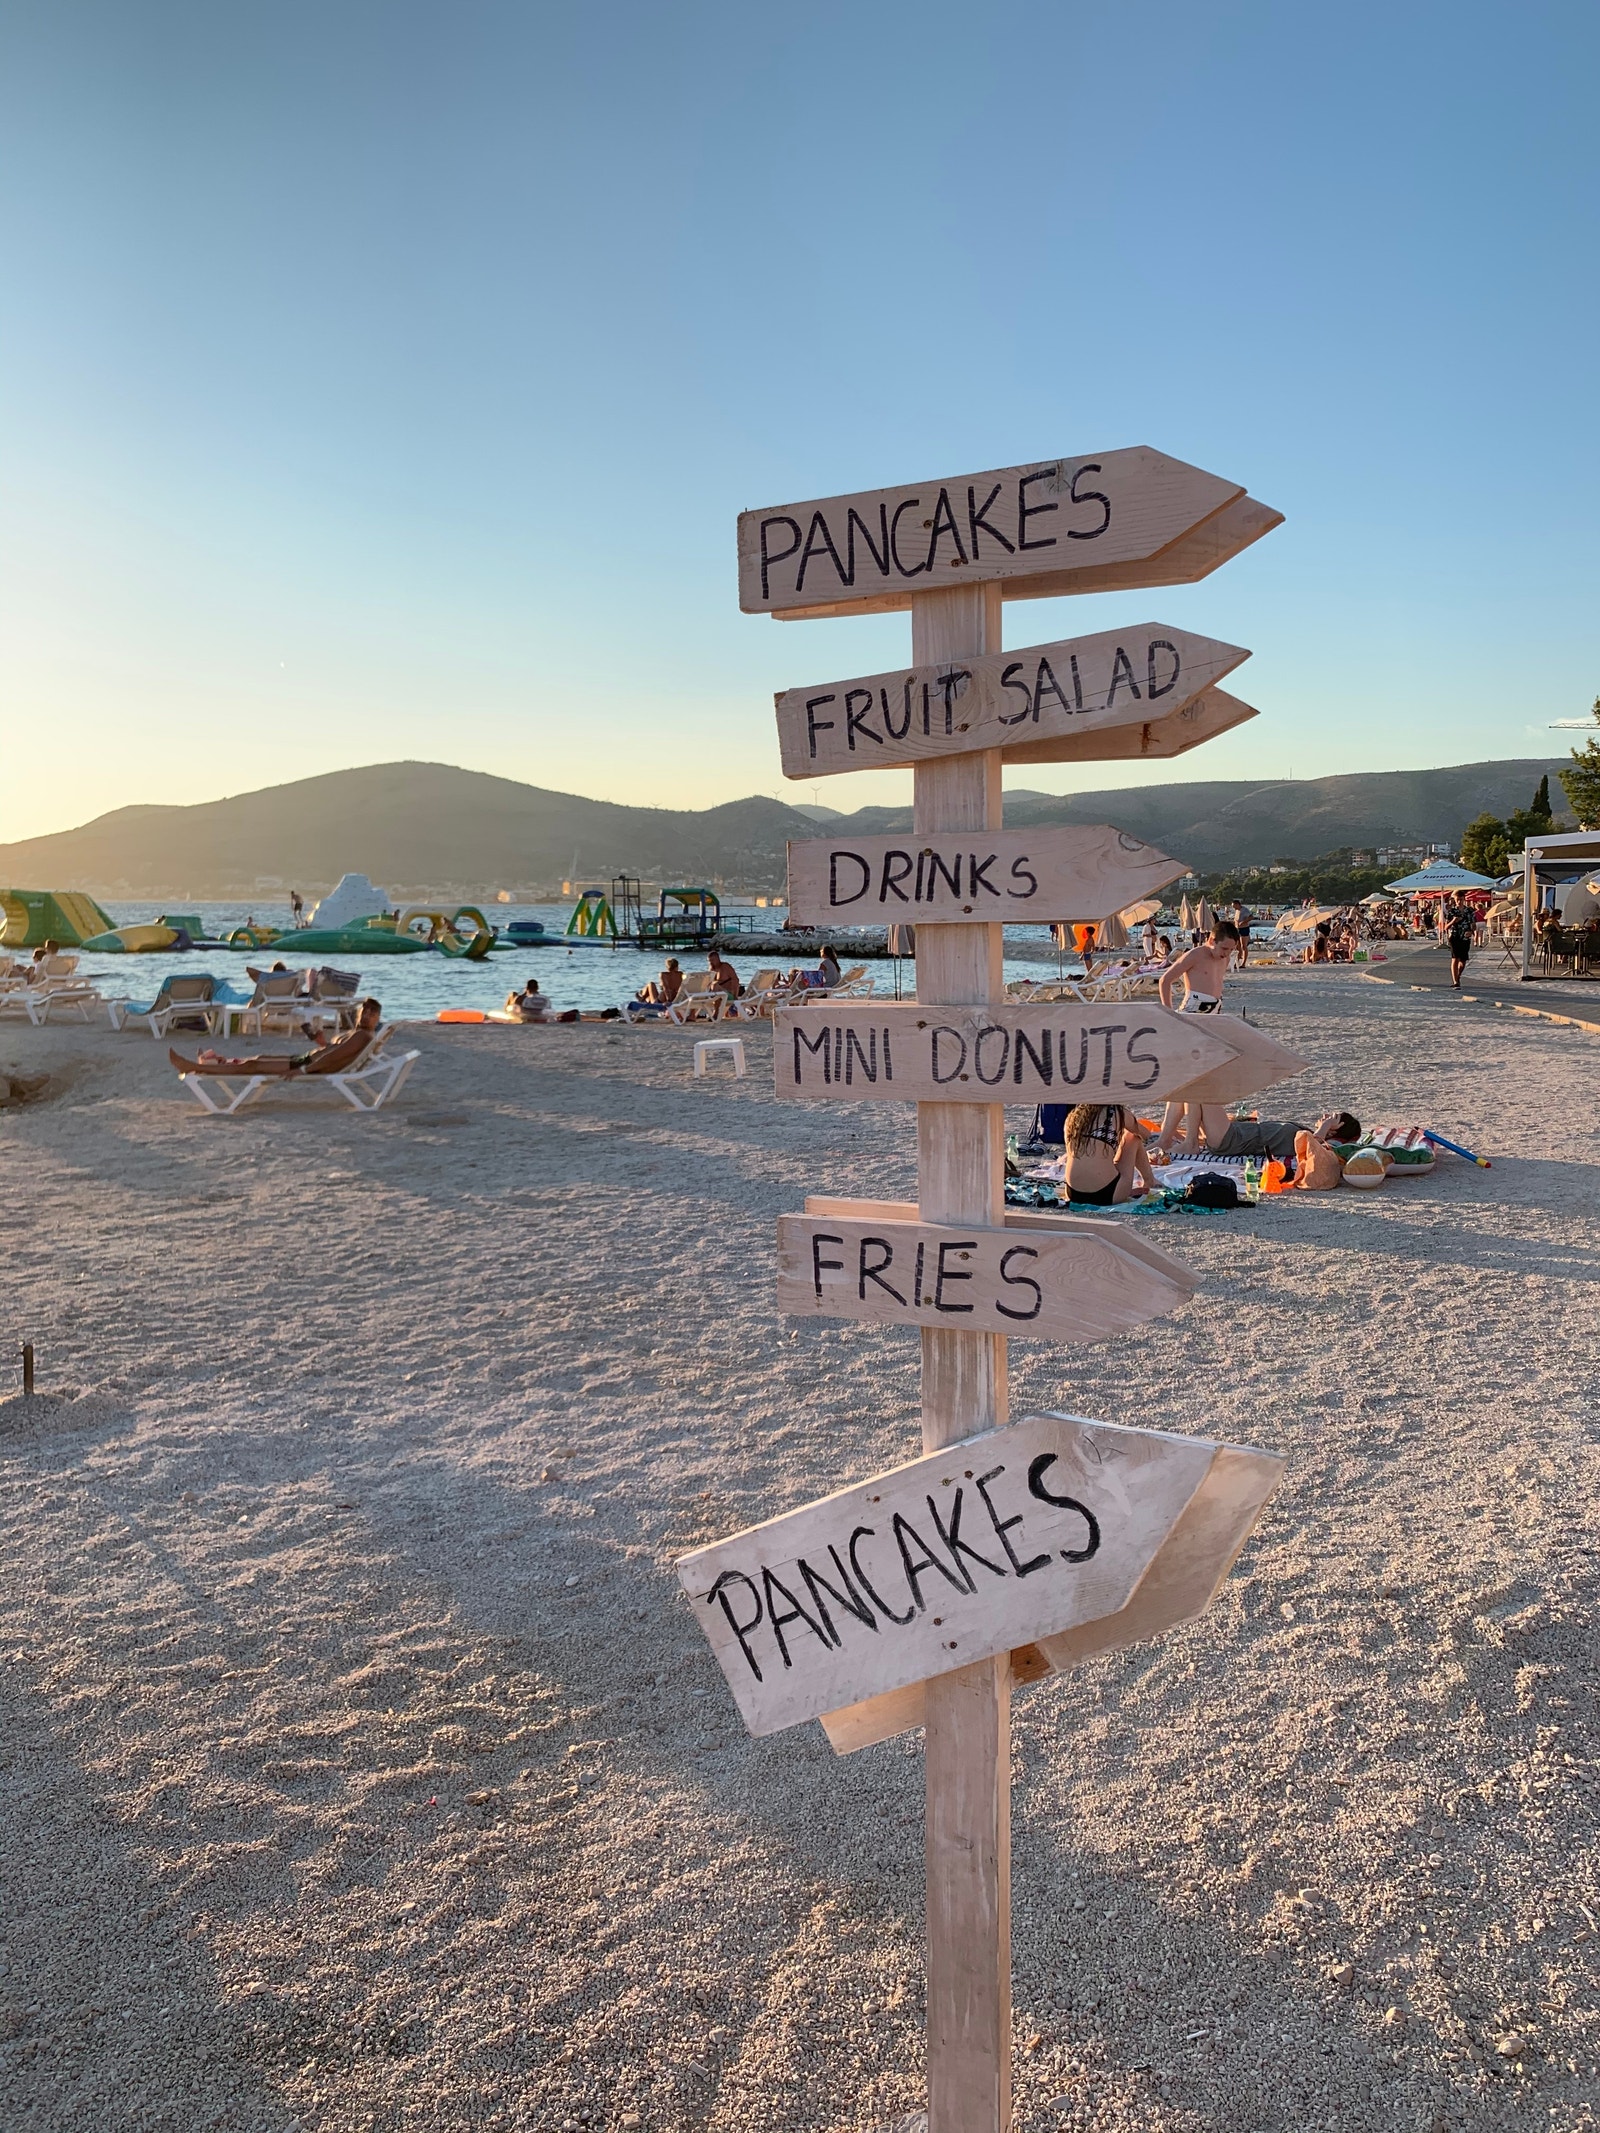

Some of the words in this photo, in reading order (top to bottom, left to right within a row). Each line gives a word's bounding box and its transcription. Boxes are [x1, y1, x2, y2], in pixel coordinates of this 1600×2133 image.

[760, 464, 1112, 600] PANCAKES
[805, 673, 972, 759] FRUIT
[998, 639, 1181, 726] SALAD
[829, 850, 1039, 907] DRINKS
[793, 1025, 893, 1084] MINI
[931, 1025, 1161, 1090] DONUTS
[811, 1233, 1043, 1321] FRIES
[706, 1452, 1101, 1682] PANCAKES
